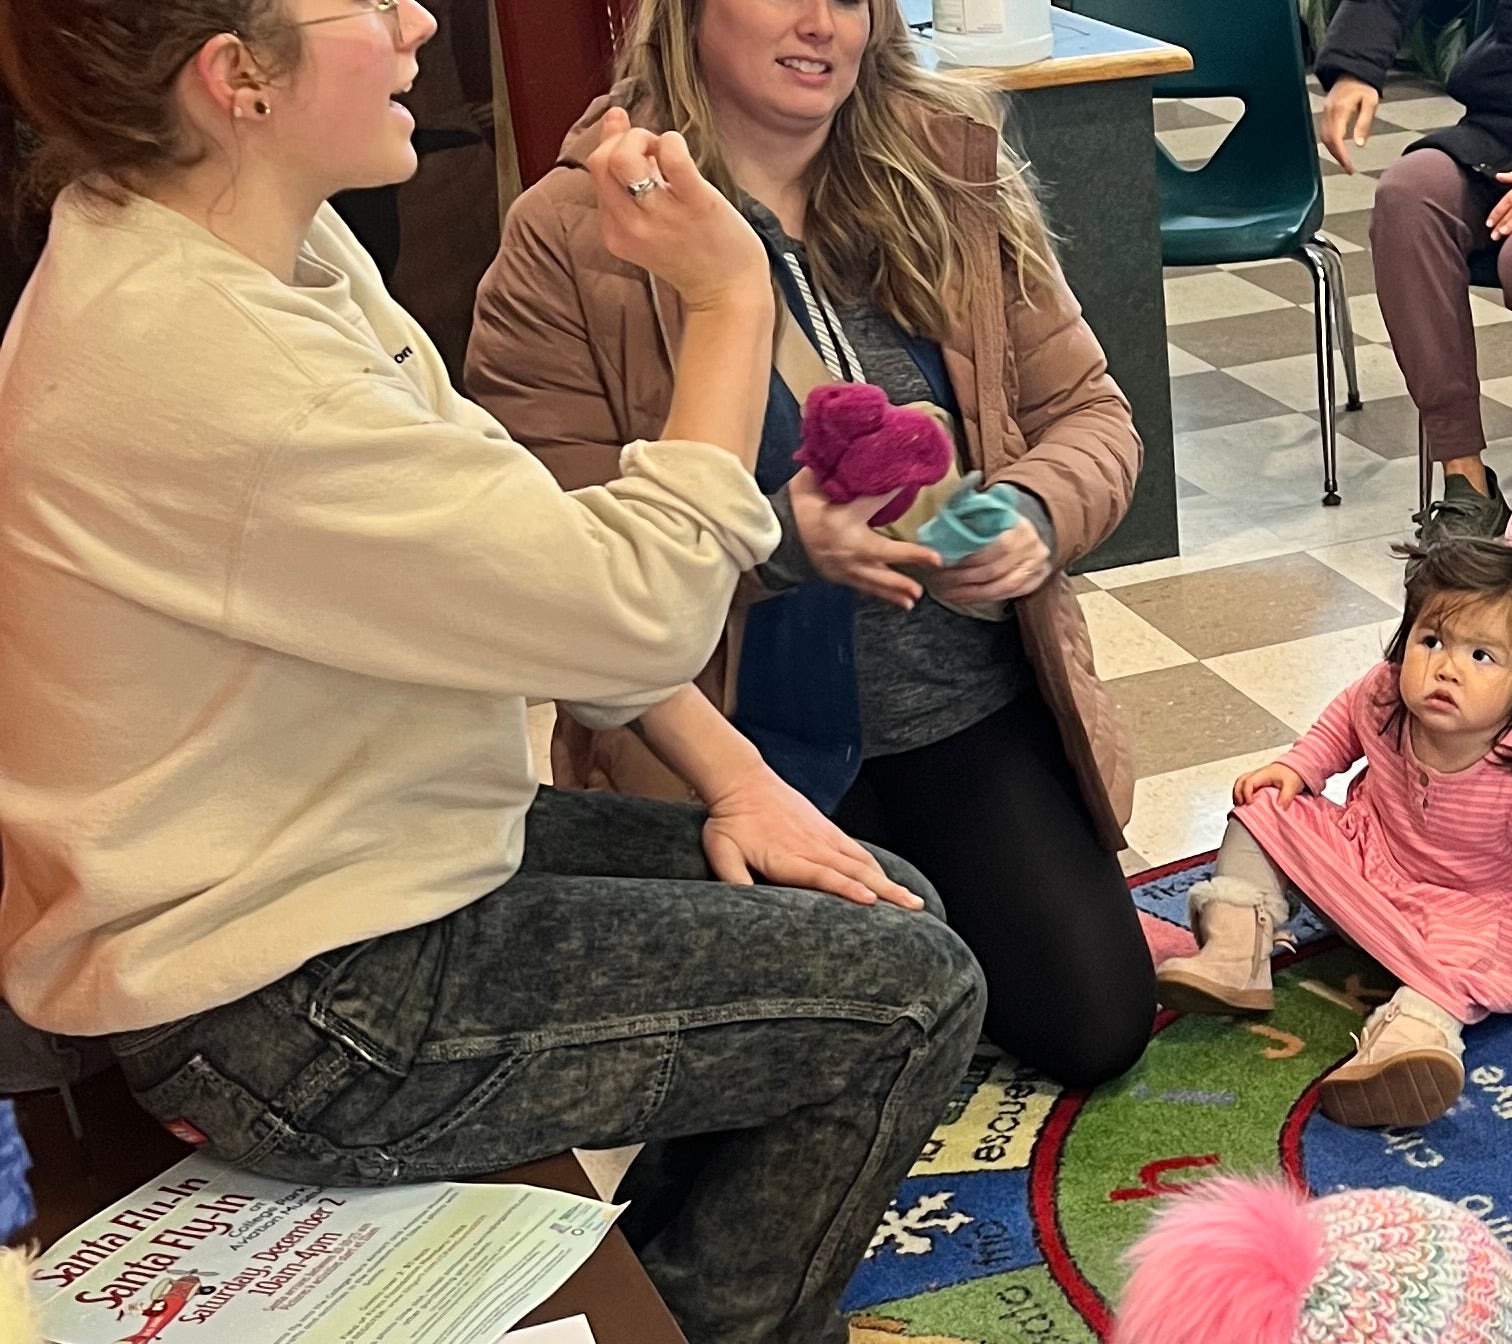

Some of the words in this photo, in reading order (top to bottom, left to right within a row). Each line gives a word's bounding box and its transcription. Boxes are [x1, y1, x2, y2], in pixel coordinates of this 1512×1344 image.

[75, 1252, 181, 1309] Santa
[149, 1193, 255, 1251] Fly-In
[229, 1215, 284, 1251] Aviation
[280, 1186, 328, 1216] Museu
[229, 1206, 279, 1238] College
[32, 1232, 134, 1288] Santa
[179, 1265, 273, 1324] Saturday,
[250, 1207, 333, 1262] December
[318, 1197, 346, 1206] 2
[248, 1232, 343, 1297] 10am-4pm
